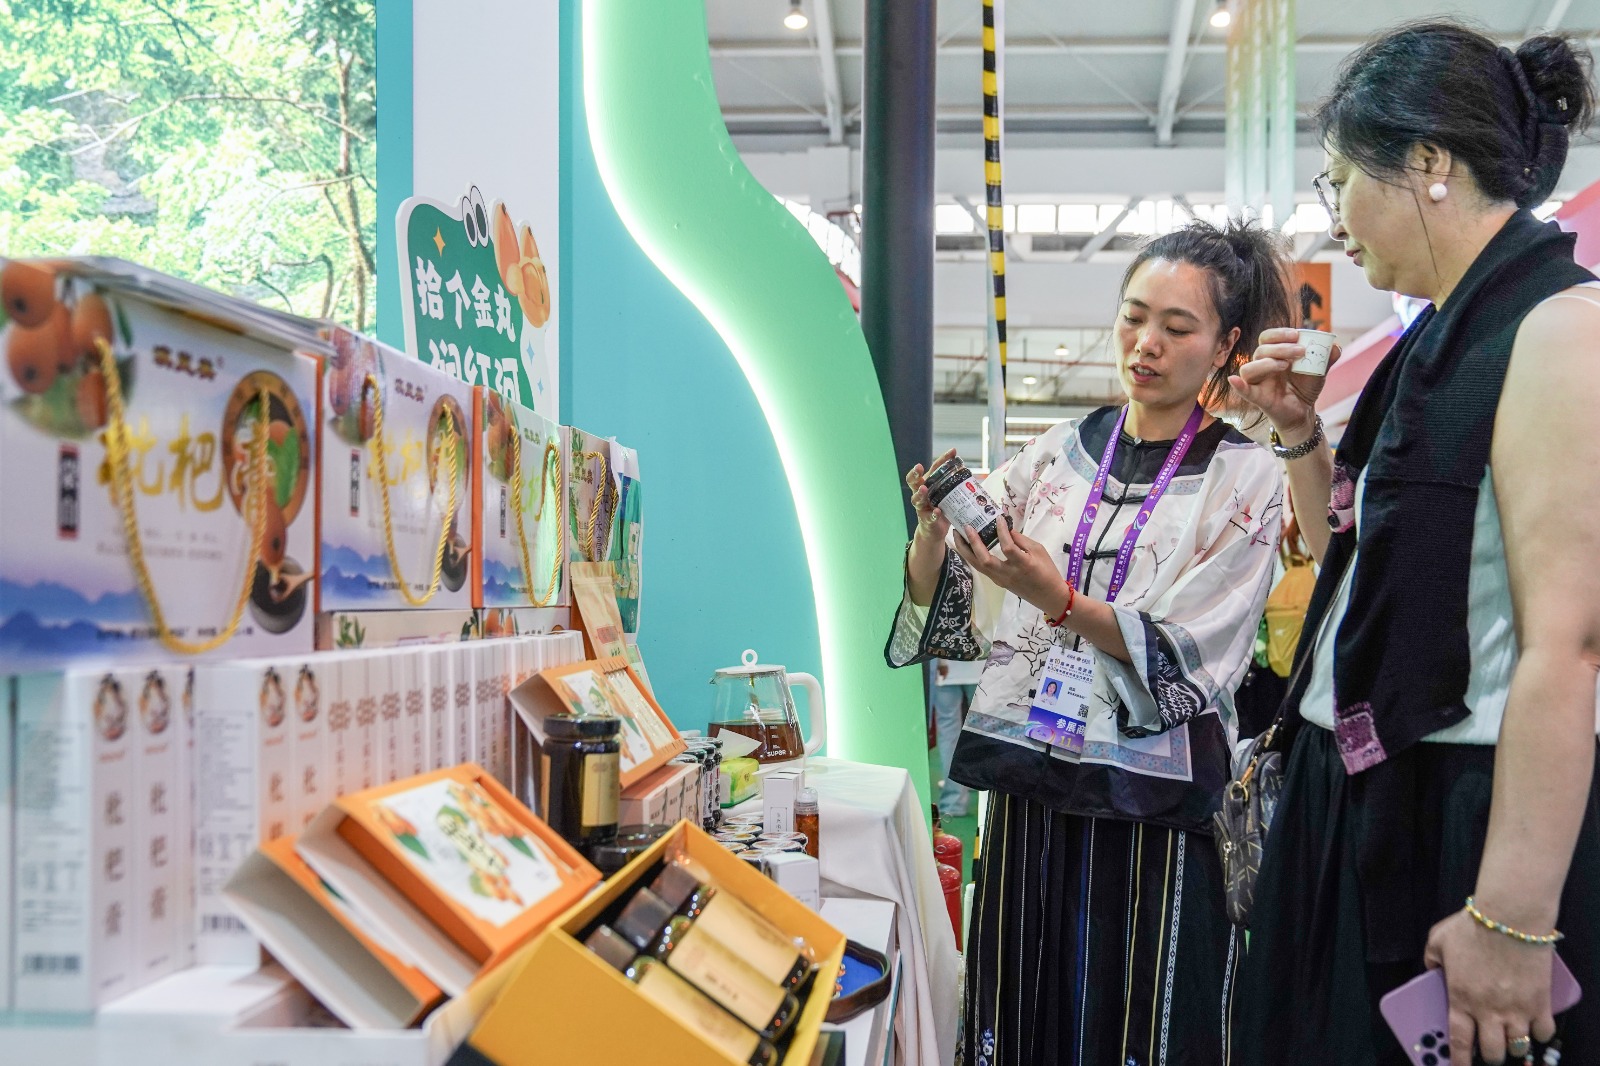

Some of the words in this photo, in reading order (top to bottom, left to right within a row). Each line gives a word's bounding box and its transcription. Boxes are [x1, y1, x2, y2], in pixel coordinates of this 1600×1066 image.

[415, 256, 516, 343] 拾个金丸
[1056, 717, 1086, 736] 参展商
